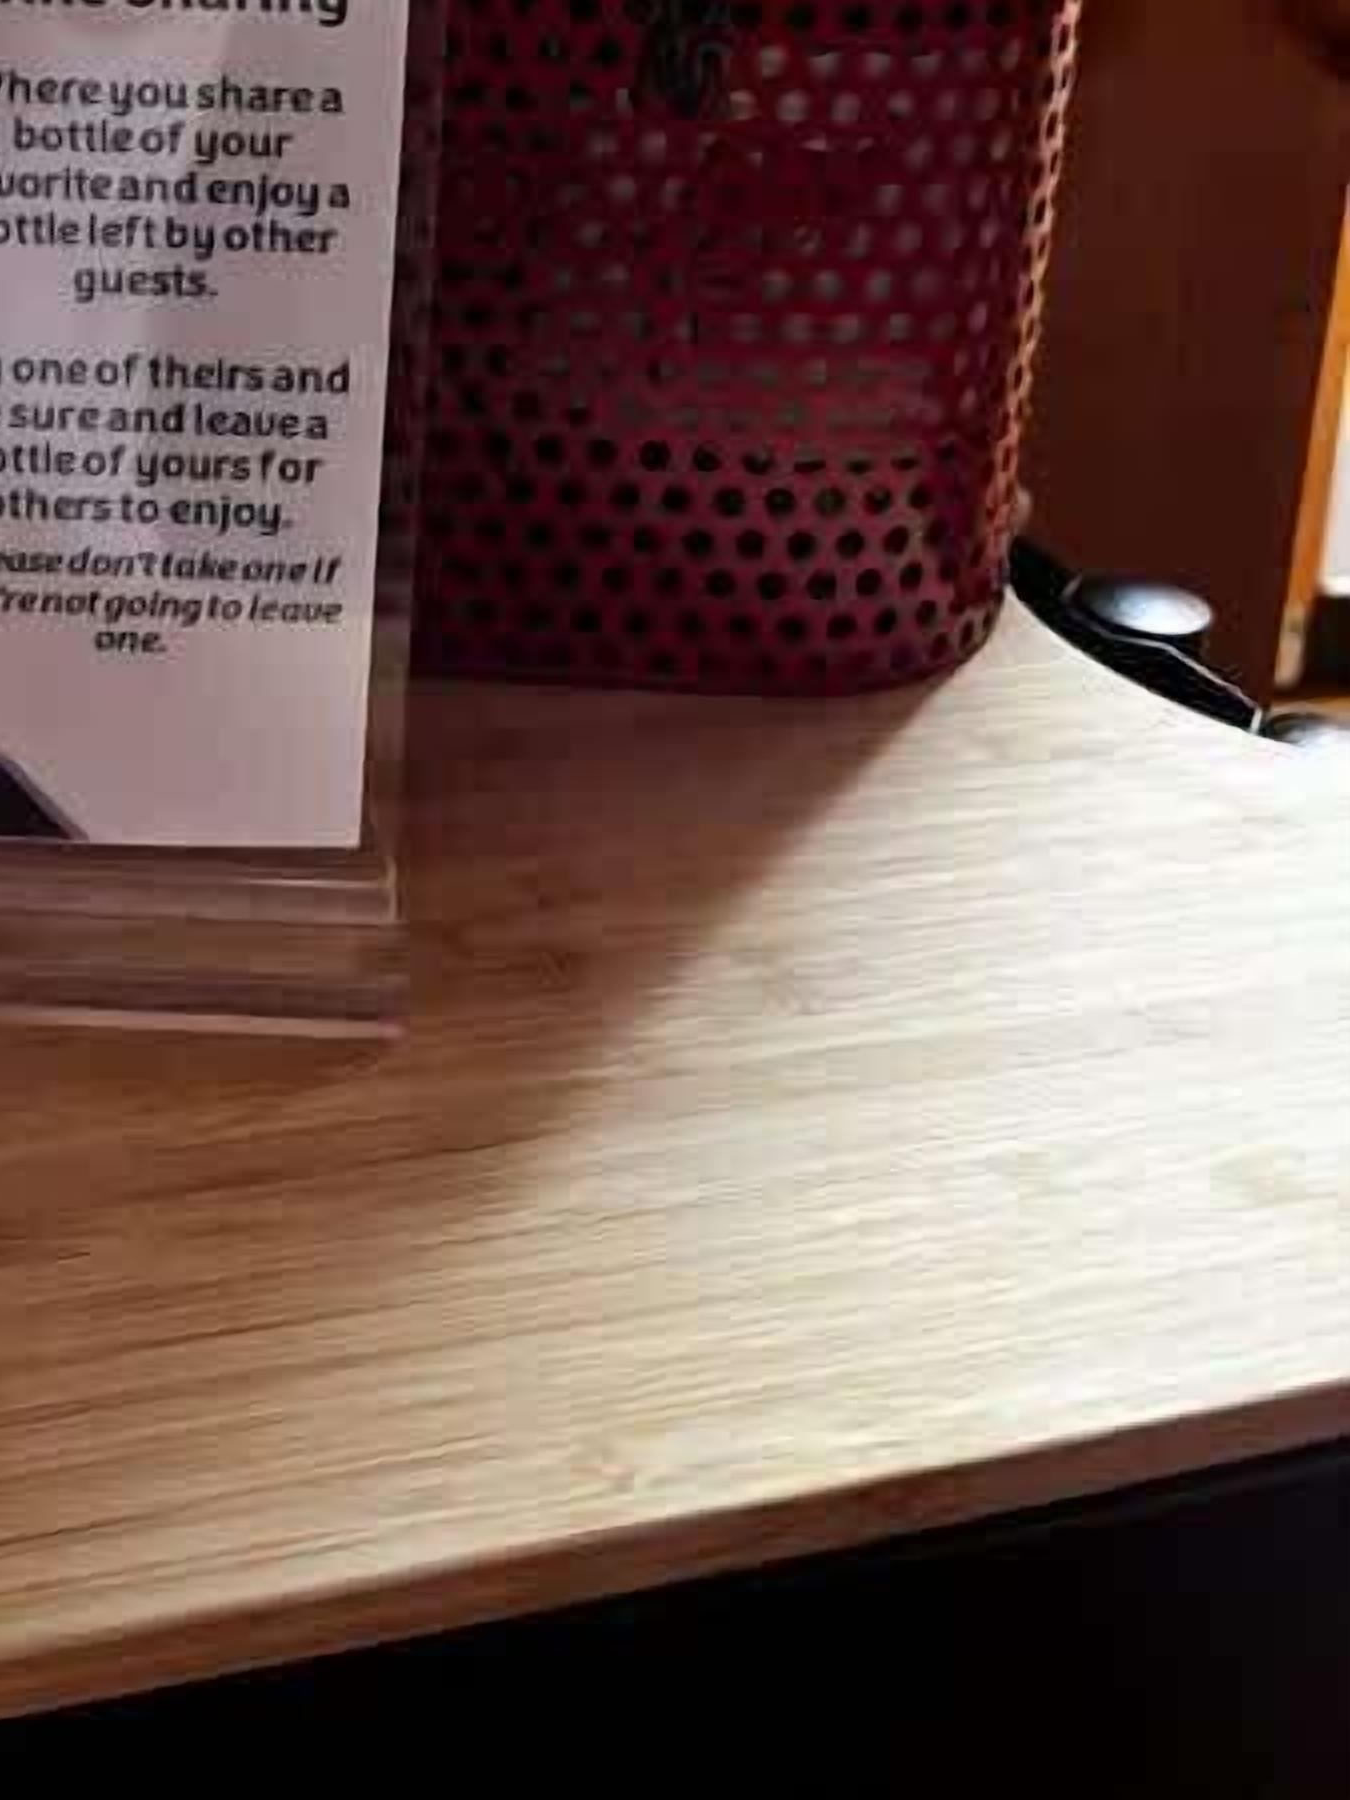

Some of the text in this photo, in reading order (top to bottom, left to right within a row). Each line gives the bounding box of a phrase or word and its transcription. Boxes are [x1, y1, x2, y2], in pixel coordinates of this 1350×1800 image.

[108, 79, 189, 116] you
[196, 74, 314, 113] share
[319, 86, 343, 114] a
[13, 116, 293, 165] bottle of your
[118, 171, 197, 204] and
[206, 173, 320, 217] enjoy
[329, 182, 351, 209] a
[88, 213, 155, 248] left
[165, 217, 216, 259] by
[223, 218, 338, 254] other
[74, 264, 219, 302] guests.
[12, 355, 88, 386] one
[95, 354, 141, 388] of
[148, 355, 264, 393] theirs
[270, 361, 351, 395] and
[8, 403, 102, 431] sure
[106, 403, 186, 435] and
[193, 404, 302, 438] leave
[304, 413, 328, 440] a
[81, 444, 127, 477] of
[135, 450, 251, 488] yours
[259, 453, 324, 484] for
[121, 496, 159, 525] to
[169, 498, 293, 536] enjoy.
[67, 547, 160, 578] don't
[161, 552, 237, 581] take
[237, 558, 308, 584] one
[314, 555, 343, 585] if
[36, 589, 101, 616] not
[104, 591, 202, 626] going
[208, 595, 244, 621] to
[248, 596, 343, 624] leave
[95, 631, 168, 653] one.
